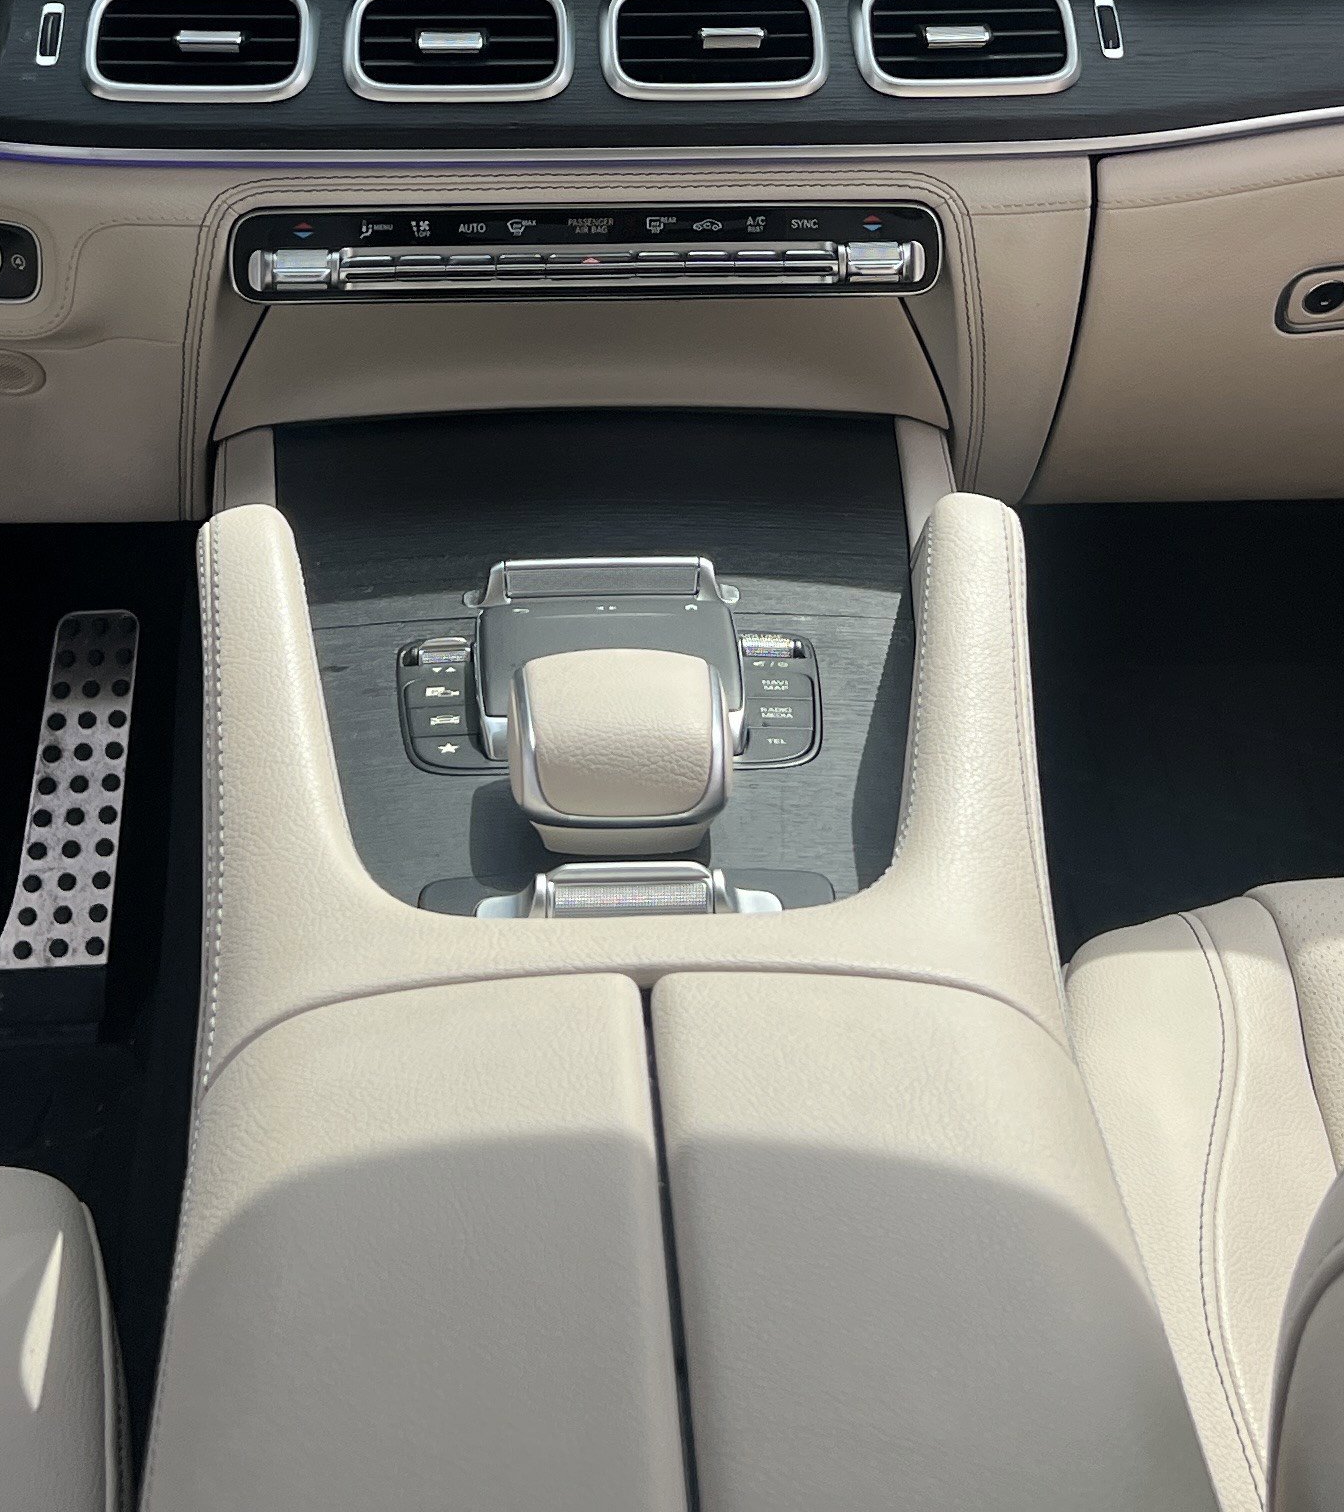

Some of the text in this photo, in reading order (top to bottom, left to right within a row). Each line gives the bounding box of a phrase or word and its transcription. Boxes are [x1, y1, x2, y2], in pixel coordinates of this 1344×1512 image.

[567, 217, 614, 226] PASSENGER
[660, 216, 677, 224] REAR
[746, 216, 767, 226] A/C
[791, 219, 819, 229] SYNC
[373, 223, 394, 231] MENU
[458, 223, 486, 234] AUTO
[575, 226, 608, 234] AIR BAG
[766, 737, 787, 745] TEL
